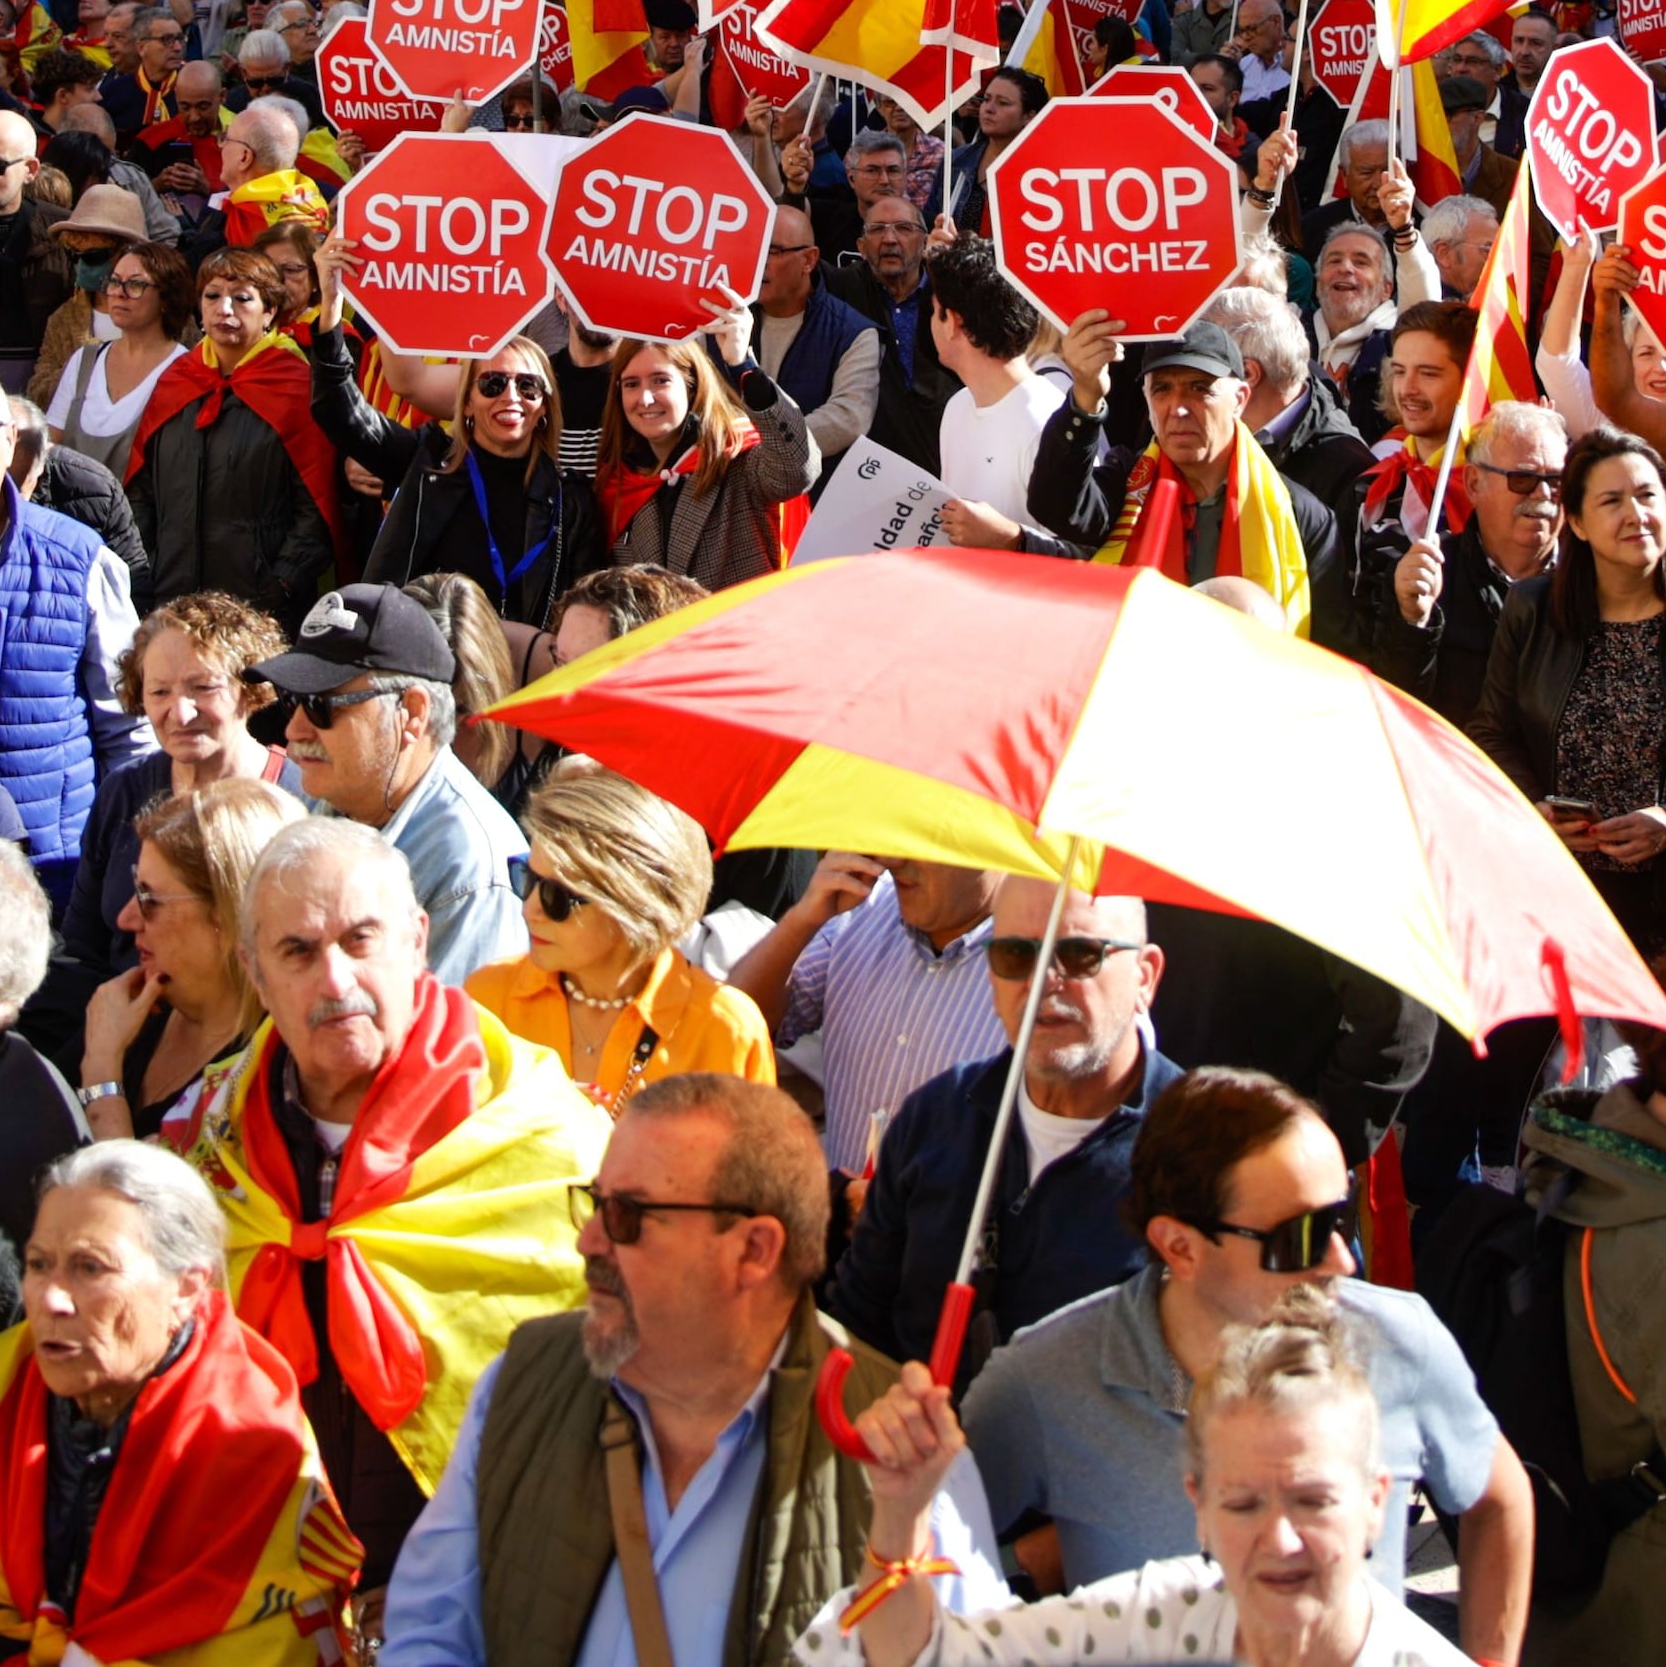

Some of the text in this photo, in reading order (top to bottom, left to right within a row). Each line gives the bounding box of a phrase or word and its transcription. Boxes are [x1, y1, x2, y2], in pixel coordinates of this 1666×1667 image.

[385, 21, 517, 60] AMNISTÍA
[541, 14, 562, 52] OP
[330, 55, 397, 97] STO
[540, 46, 573, 75] CHEZ
[729, 37, 800, 81] AMNISTÍA
[1323, 59, 1366, 76] AMNIS
[333, 98, 437, 122] AMNISTÍA
[1547, 68, 1643, 175] STOP
[1533, 117, 1613, 217] AMNISTÍA
[575, 168, 749, 252] STOP
[1020, 166, 1209, 233] STOP
[361, 192, 530, 257] STOP
[563, 234, 731, 291] AMNISTÍA
[1024, 235, 1211, 274] SÁNCHEZ
[359, 259, 527, 297] AMNISTÍA
[873, 480, 932, 551] ldad de
